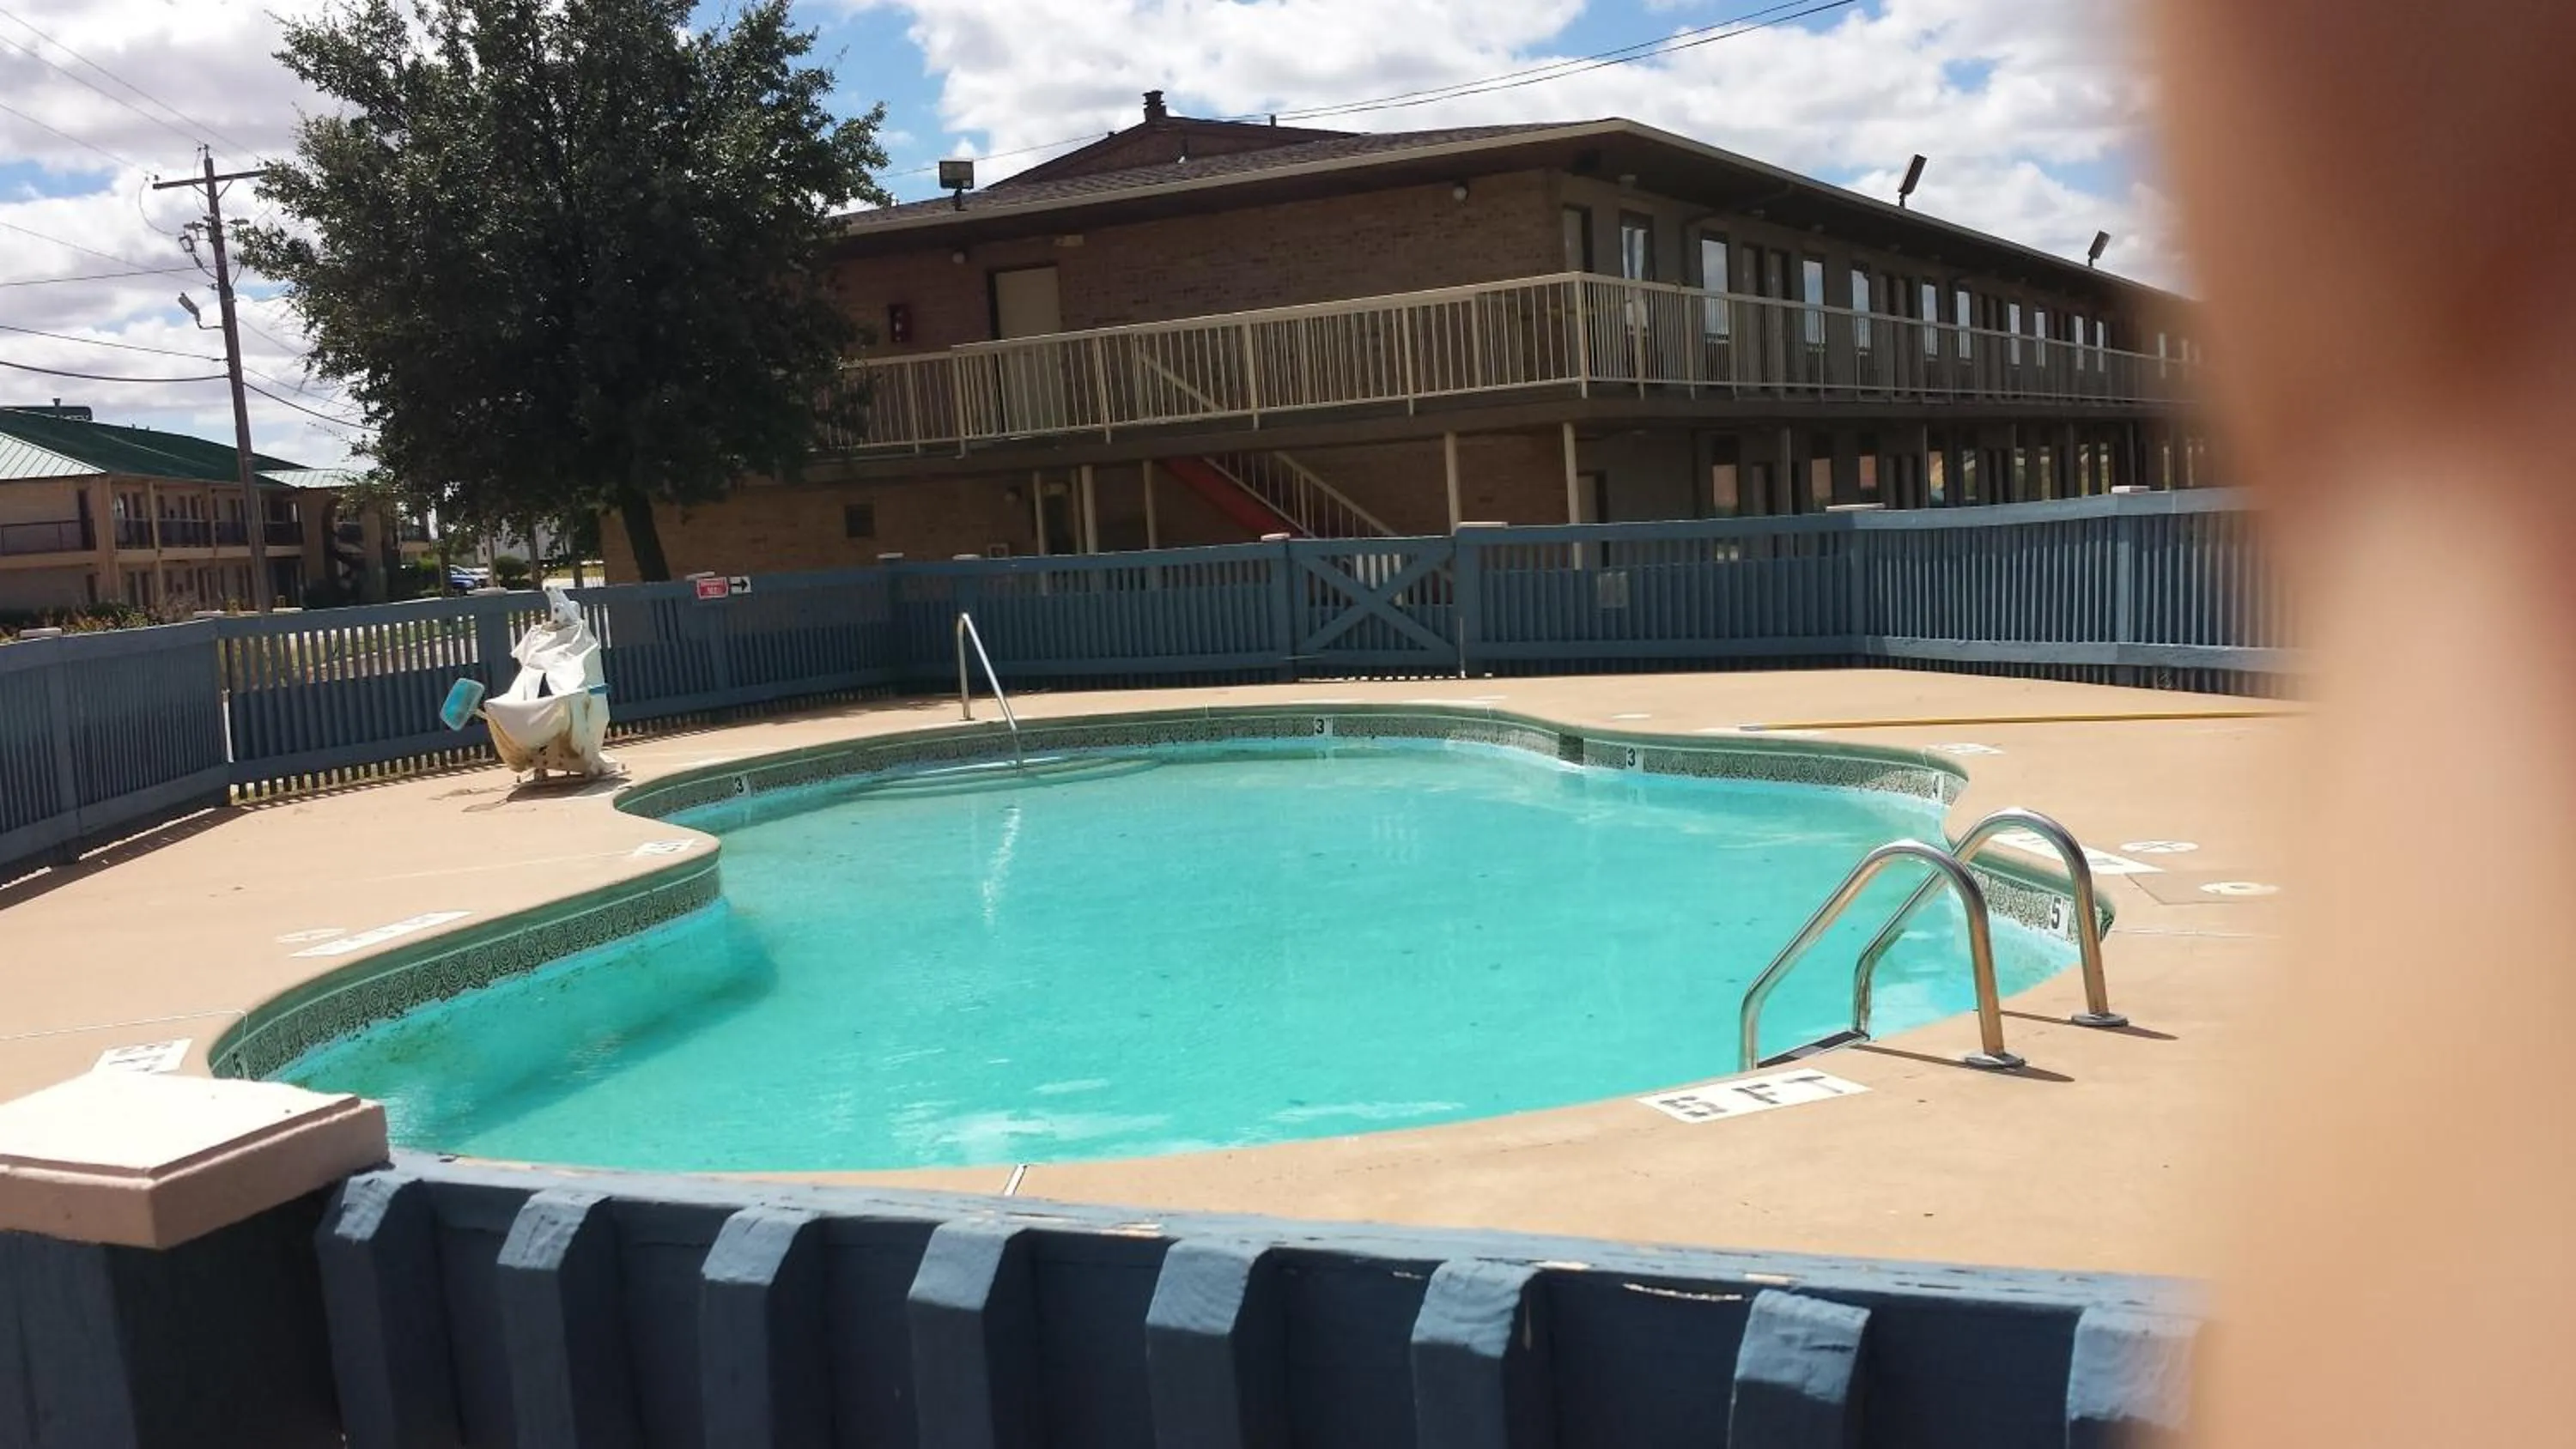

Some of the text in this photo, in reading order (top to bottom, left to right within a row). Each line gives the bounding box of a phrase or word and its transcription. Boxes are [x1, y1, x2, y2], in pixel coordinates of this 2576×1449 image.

[1315, 718, 1324, 734] 3
[1628, 748, 1636, 767] 3
[735, 776, 744, 793] 3
[2051, 897, 2061, 929] 5
[1658, 1076, 1844, 1118] 5 FT
